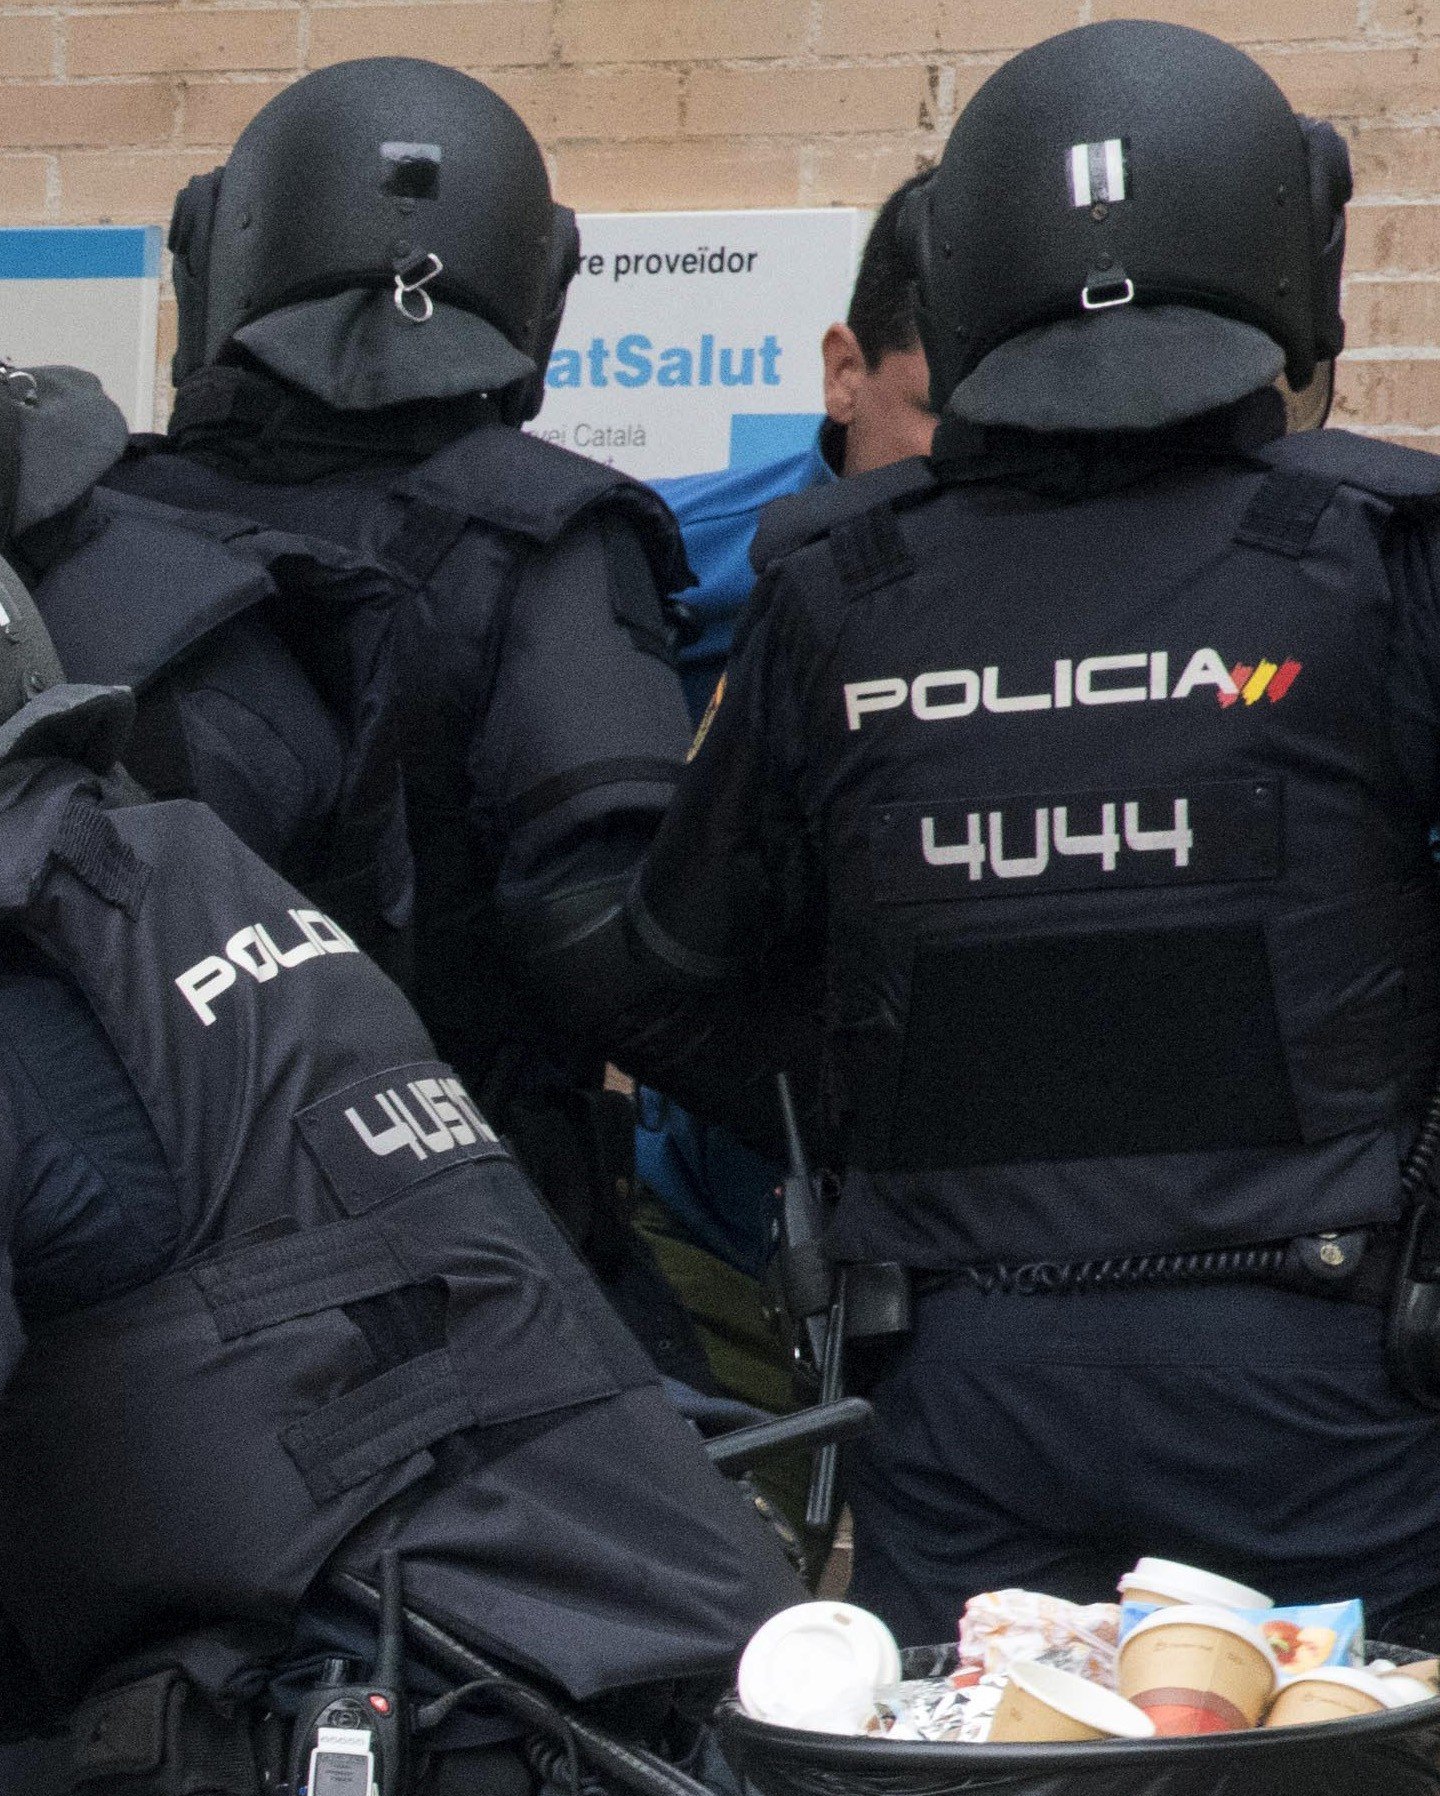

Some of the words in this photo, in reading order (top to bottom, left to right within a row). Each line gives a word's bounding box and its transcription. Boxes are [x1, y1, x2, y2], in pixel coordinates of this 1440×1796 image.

[613, 246, 758, 282] proveïdor
[545, 334, 781, 388] atSalut
[574, 423, 647, 448] Català
[844, 647, 1238, 730] POLICIA
